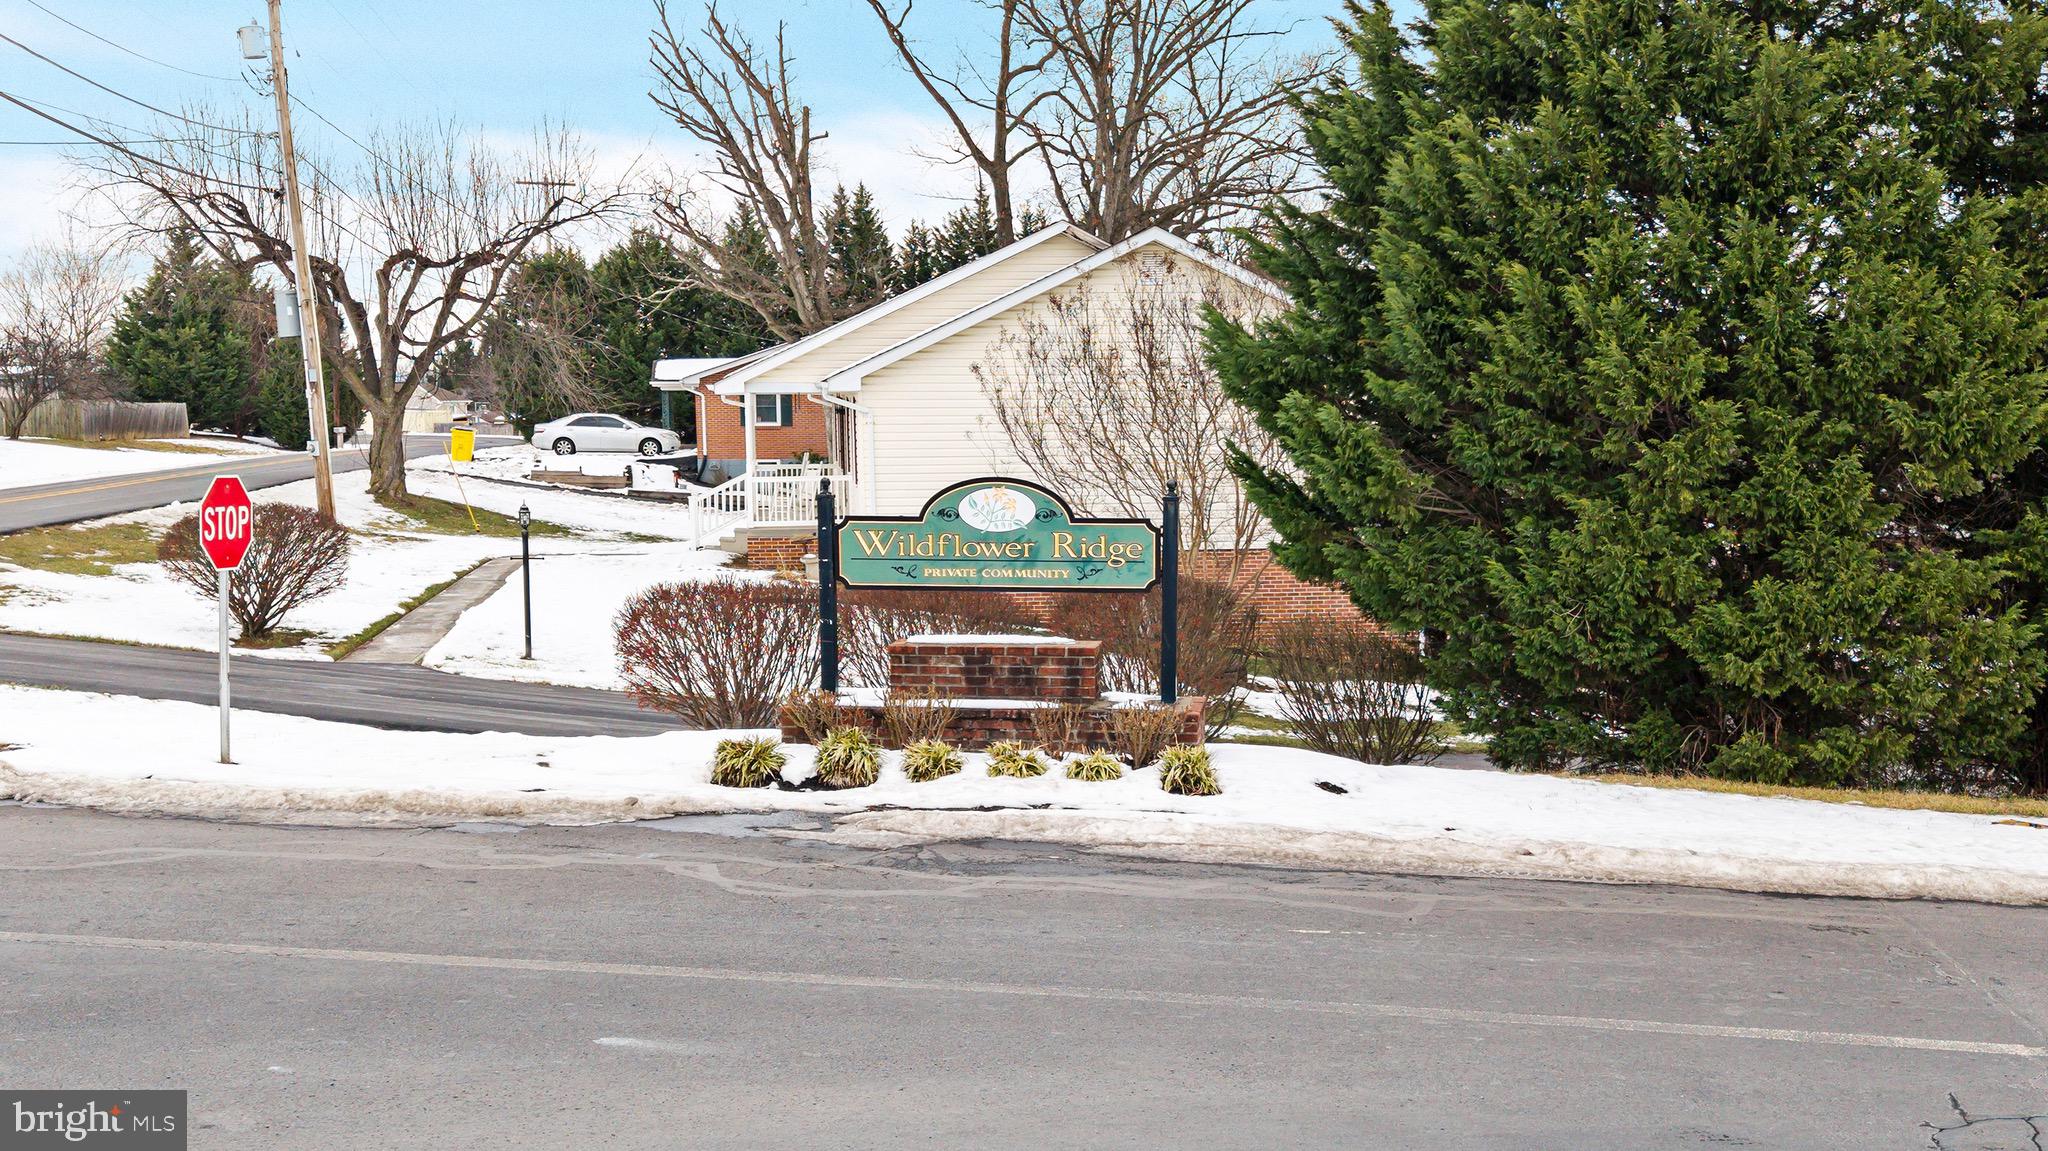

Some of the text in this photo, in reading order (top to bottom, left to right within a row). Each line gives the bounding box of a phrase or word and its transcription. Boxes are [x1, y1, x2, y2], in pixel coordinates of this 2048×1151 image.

[204, 505, 249, 541] STOP
[853, 529, 1143, 568] Wildflower Ridge
[923, 568, 1070, 579] PRIVATE COMMUNITY
